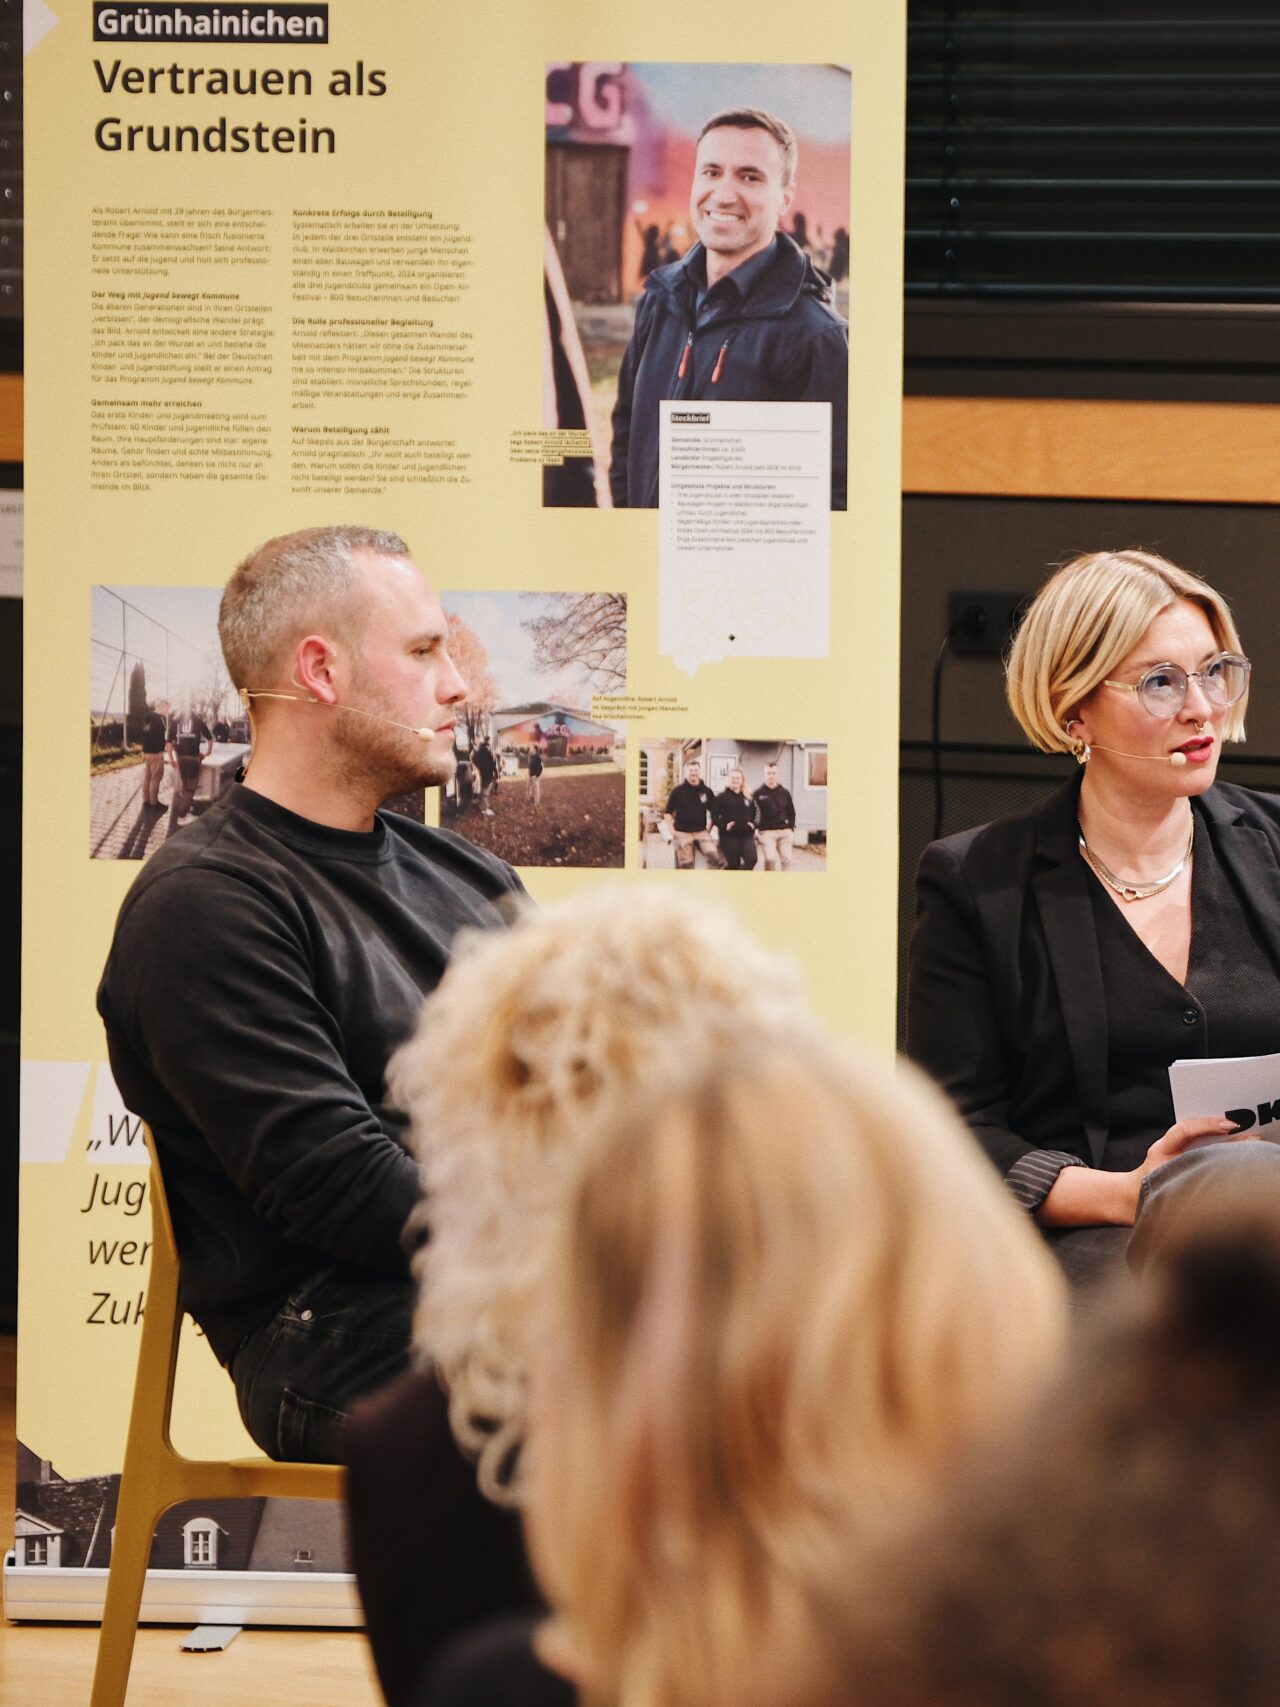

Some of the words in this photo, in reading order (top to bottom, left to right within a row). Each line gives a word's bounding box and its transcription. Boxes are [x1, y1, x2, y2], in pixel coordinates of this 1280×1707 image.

[97, 8, 325, 37] Grünhainichen
[92, 59, 313, 96] Vertrauen
[327, 60, 388, 97] als
[94, 116, 337, 154] Grundstein
[292, 209, 330, 217] Konkrete
[331, 209, 361, 219] Erfolge
[361, 209, 386, 217] durch
[386, 210, 433, 220] Beteiligung
[107, 291, 126, 300] Weg
[127, 291, 142, 299] mit
[141, 291, 170, 301] Jugend
[171, 292, 200, 301] bewegt
[201, 292, 240, 300] Kommune
[292, 317, 306, 325] Die
[307, 317, 328, 325] Rolle
[328, 317, 389, 328] professioneller
[390, 318, 434, 328] Begleitung
[90, 399, 139, 407] Gemeinsam
[140, 399, 162, 407] mehr
[163, 399, 203, 408] erreichen
[322, 426, 369, 436] Beteiligung
[369, 426, 390, 434] zählt
[86, 1114, 149, 1151] „W
[80, 1173, 147, 1216] Jug
[89, 1240, 153, 1265] wer
[86, 1292, 145, 1325] Zuk
